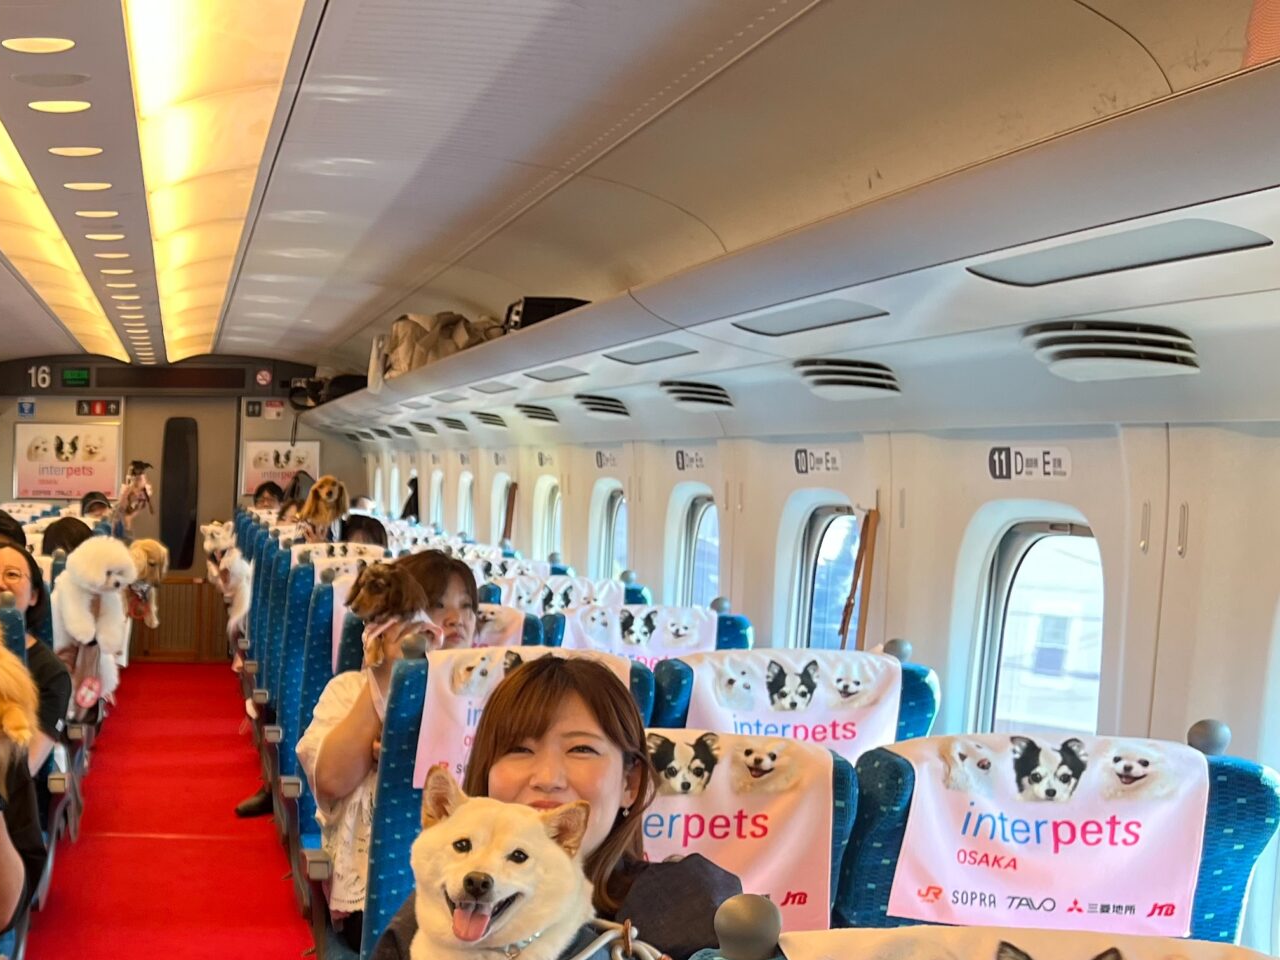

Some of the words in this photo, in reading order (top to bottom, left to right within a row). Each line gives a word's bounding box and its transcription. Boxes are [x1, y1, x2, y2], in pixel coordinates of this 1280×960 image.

[28, 366, 51, 388] 16
[39, 464, 94, 478] interpets
[797, 451, 806, 472] 10
[809, 452, 814, 471] D
[825, 451, 830, 471] E
[993, 451, 1007, 476] 11
[1015, 451, 1024, 475] D
[1042, 451, 1051, 475] E
[643, 809, 769, 847] erpets
[960, 802, 1143, 854] interpets
[957, 849, 1018, 871] OSAKA
[781, 891, 808, 906] JTB
[917, 885, 943, 900] JR
[951, 890, 996, 909] SOPRA
[1006, 895, 1056, 912] TAVO
[1146, 902, 1176, 918] JTB
